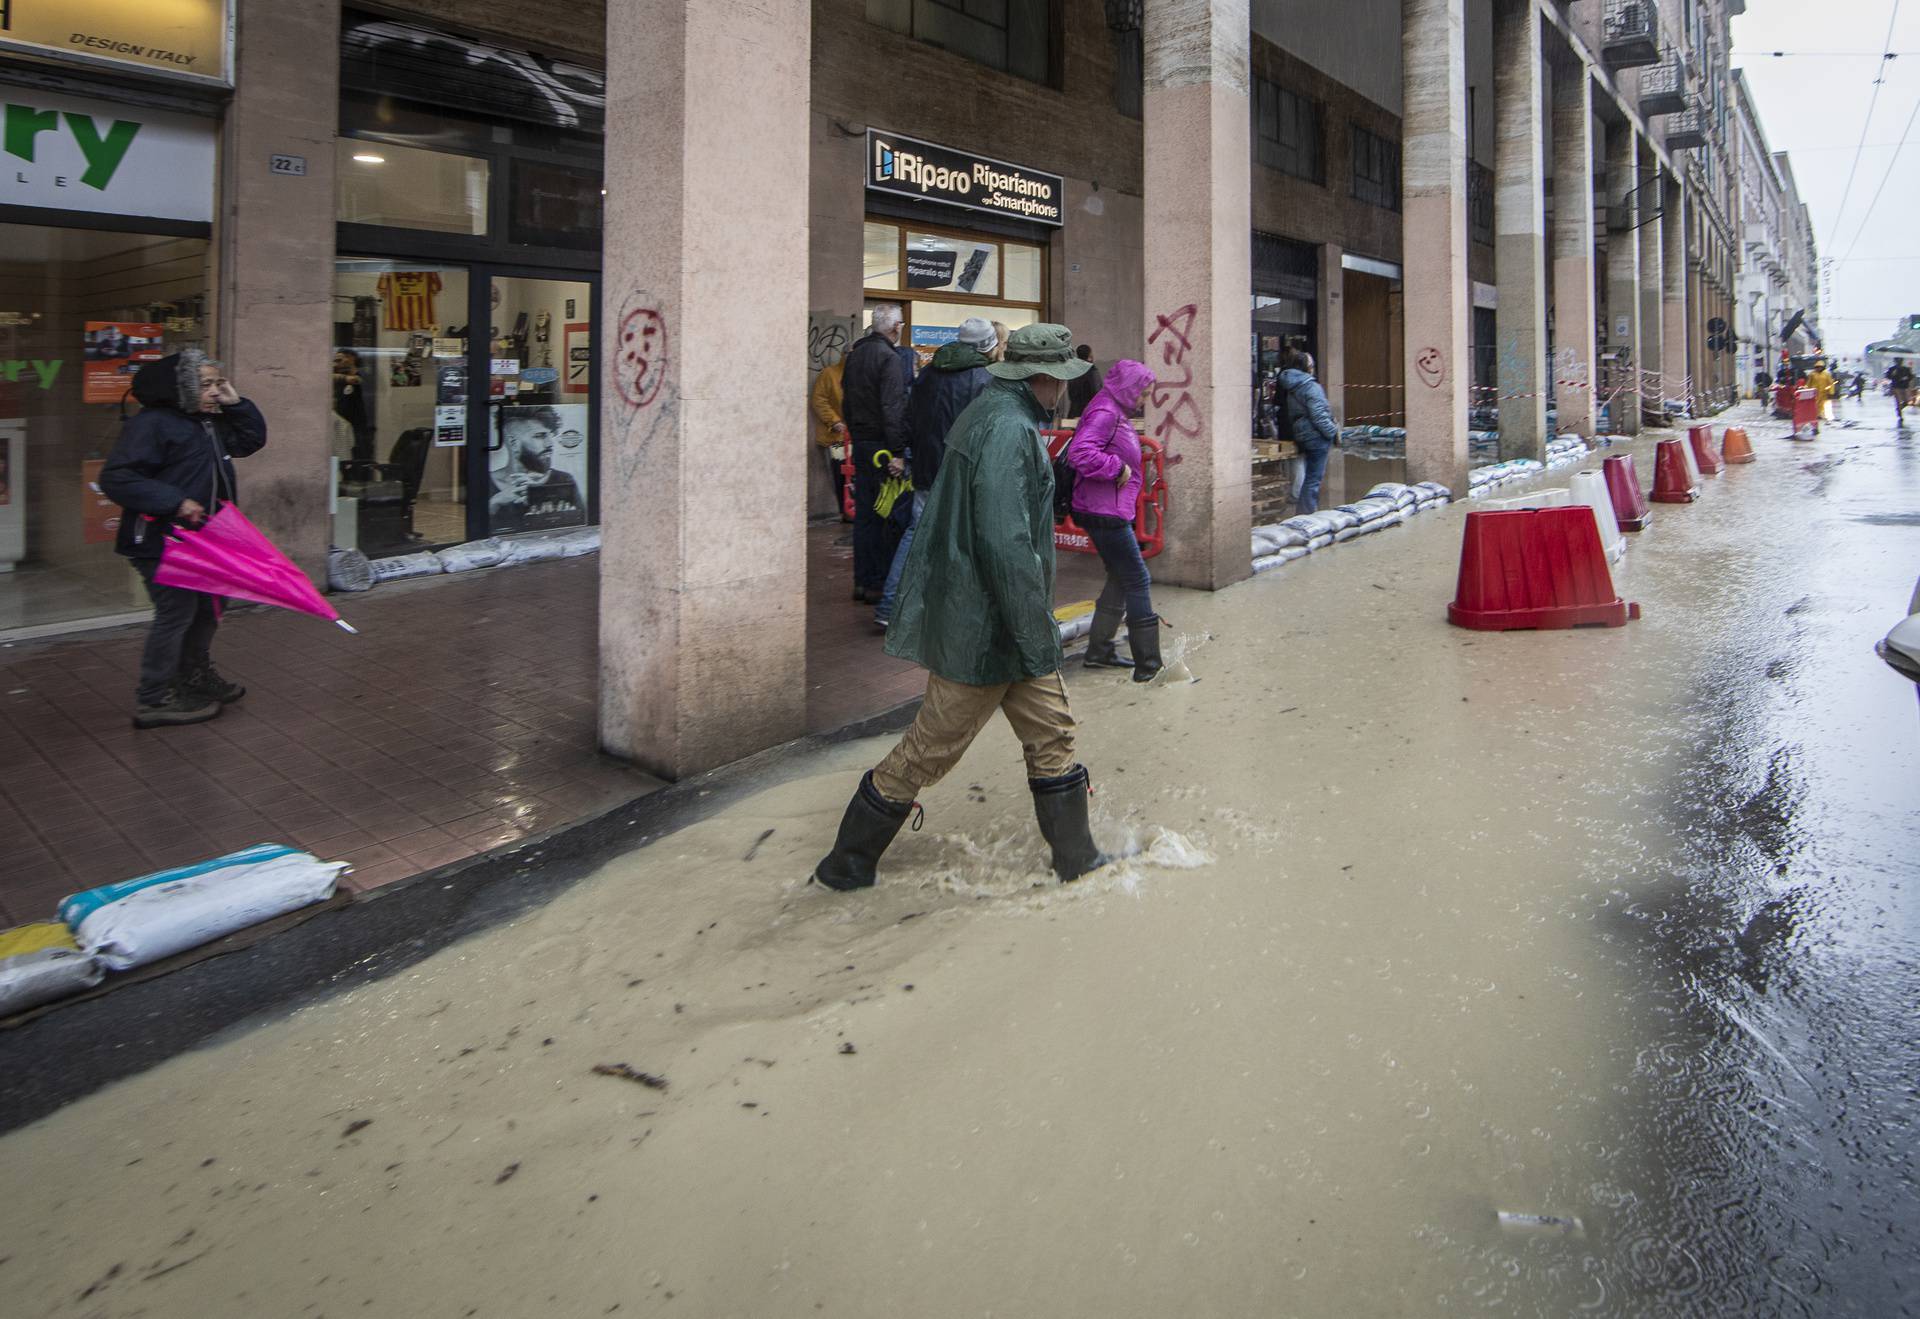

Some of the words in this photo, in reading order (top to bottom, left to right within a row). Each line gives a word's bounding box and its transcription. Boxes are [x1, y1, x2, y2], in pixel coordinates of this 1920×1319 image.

[69, 33, 145, 56] DESIGN
[146, 49, 198, 66] ITALY
[273, 158, 291, 171] 22
[973, 163, 1051, 199] Ripariamo
[993, 191, 1059, 218] Smartphone
[0, 359, 65, 390] ry
